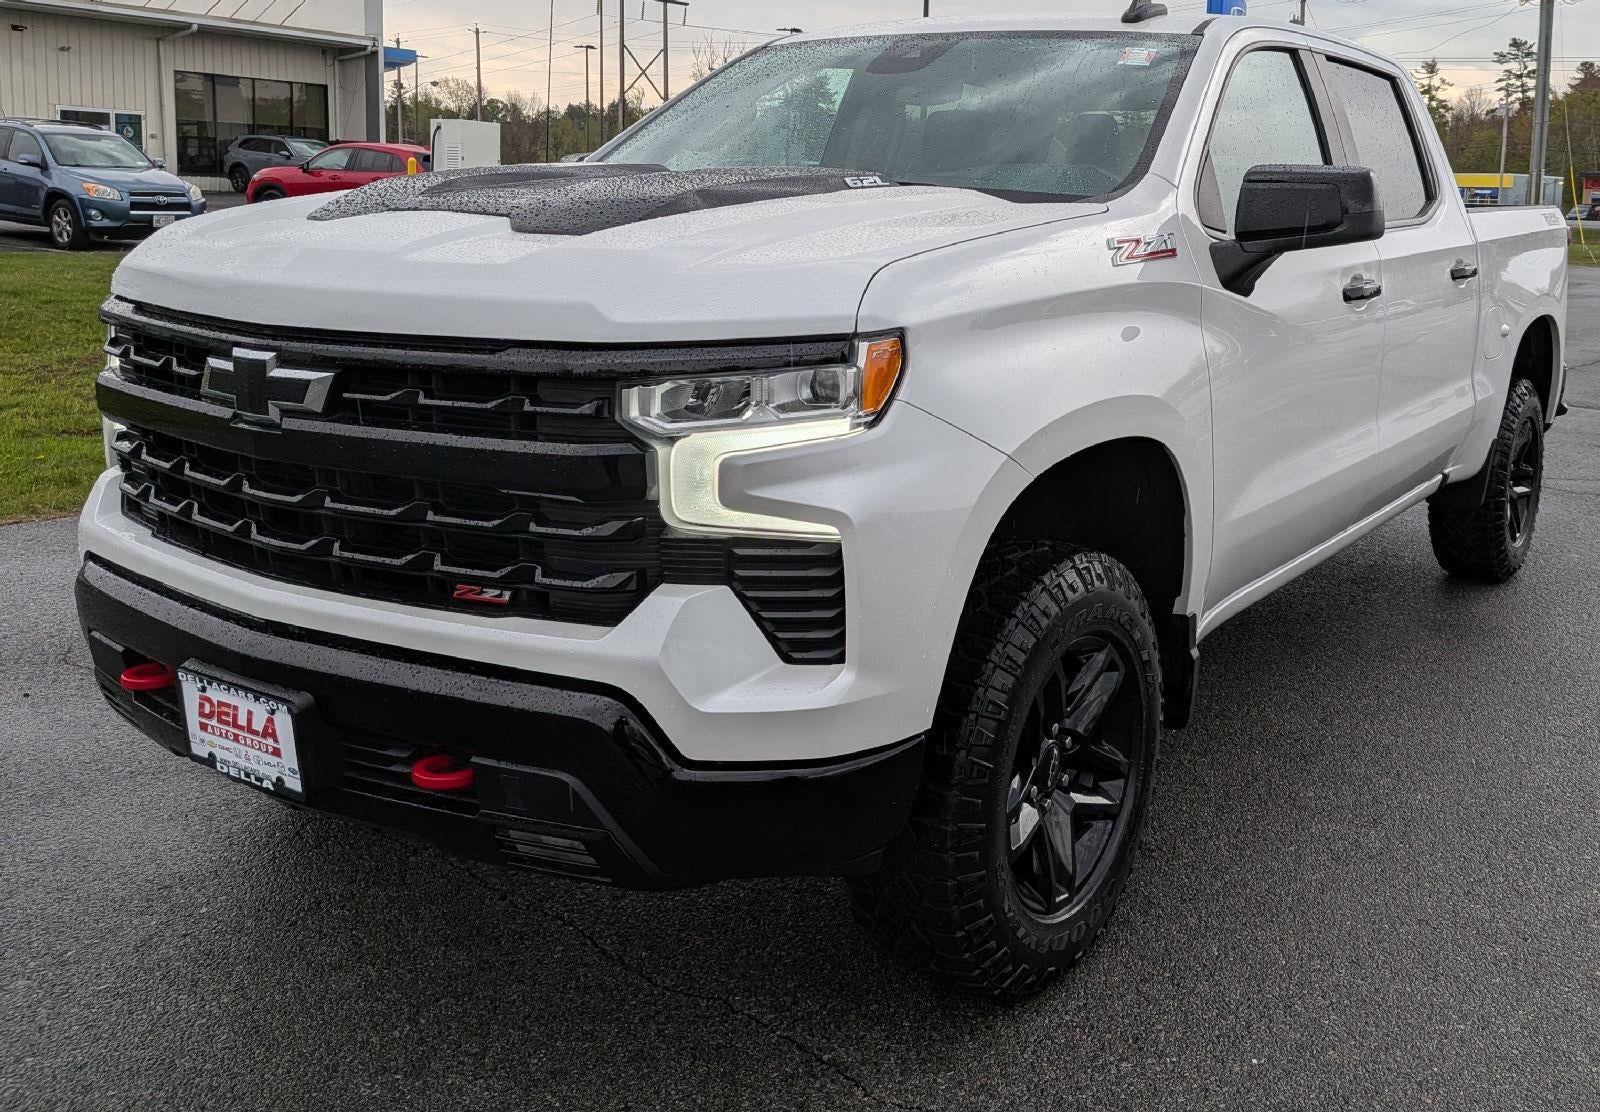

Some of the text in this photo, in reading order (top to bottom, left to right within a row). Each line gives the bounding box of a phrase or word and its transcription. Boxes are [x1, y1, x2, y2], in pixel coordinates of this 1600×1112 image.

[1106, 232, 1178, 267] Z71
[453, 584, 512, 604] Z71
[178, 671, 288, 714] DELLACARS.COM
[197, 693, 280, 744] DELLA
[207, 724, 274, 755] AUTO GROUP
[216, 762, 275, 791] DELLA
